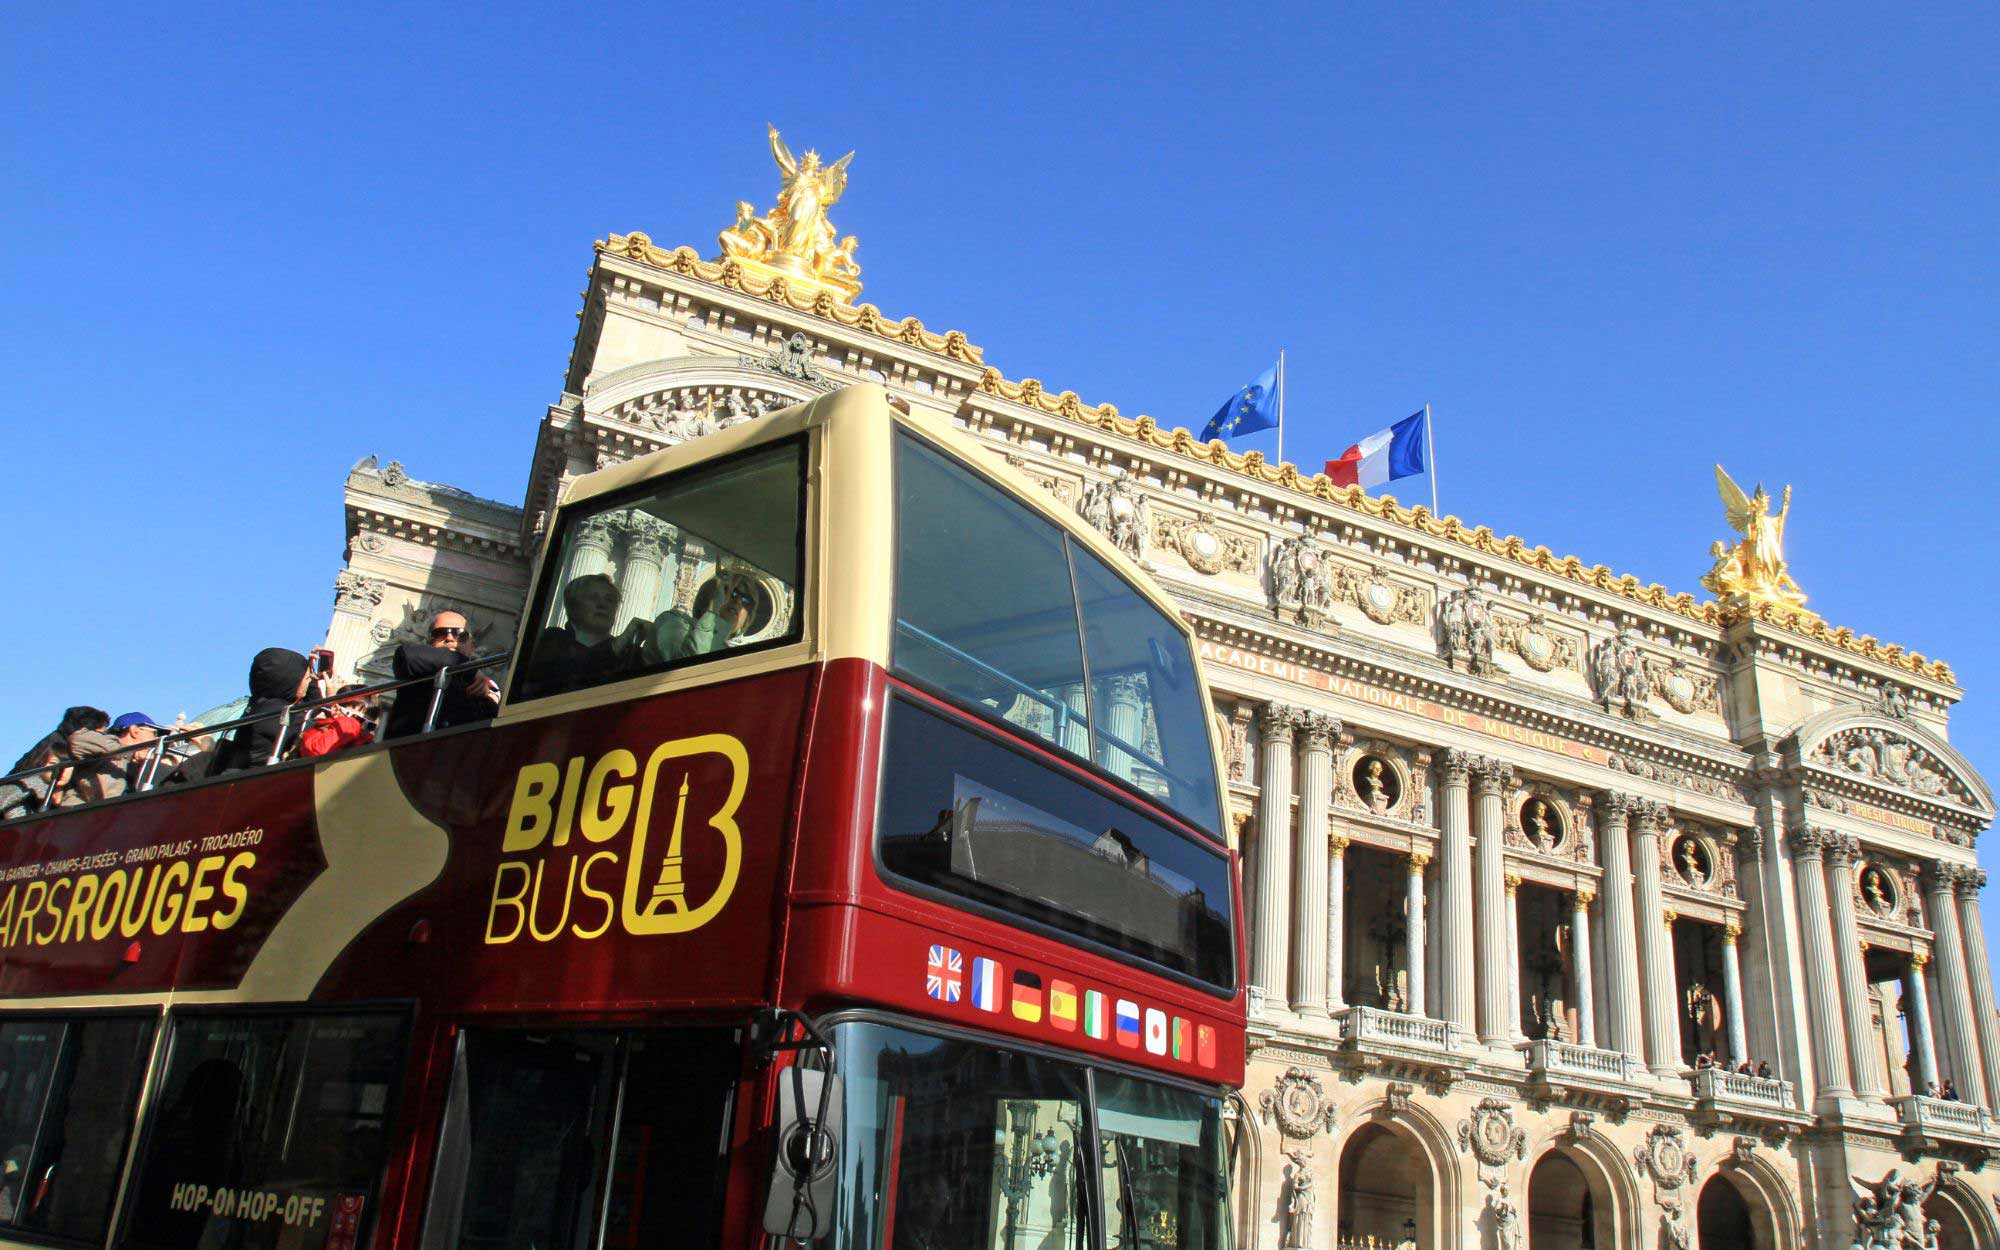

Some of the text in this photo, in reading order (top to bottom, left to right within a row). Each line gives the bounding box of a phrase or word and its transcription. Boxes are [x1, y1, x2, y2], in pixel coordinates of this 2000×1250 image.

[1200, 643, 1569, 754] ACADEMIE NATIONALE DE MUSIQUE
[502, 749, 637, 852] BIG
[6, 863, 41, 881] GARNIER
[124, 843, 159, 864] GRAND
[158, 839, 192, 858] PALAIS
[200, 826, 264, 852] TROCADÉRO
[485, 851, 619, 944] BUS
[237, 1189, 325, 1228] HOP-OFF
